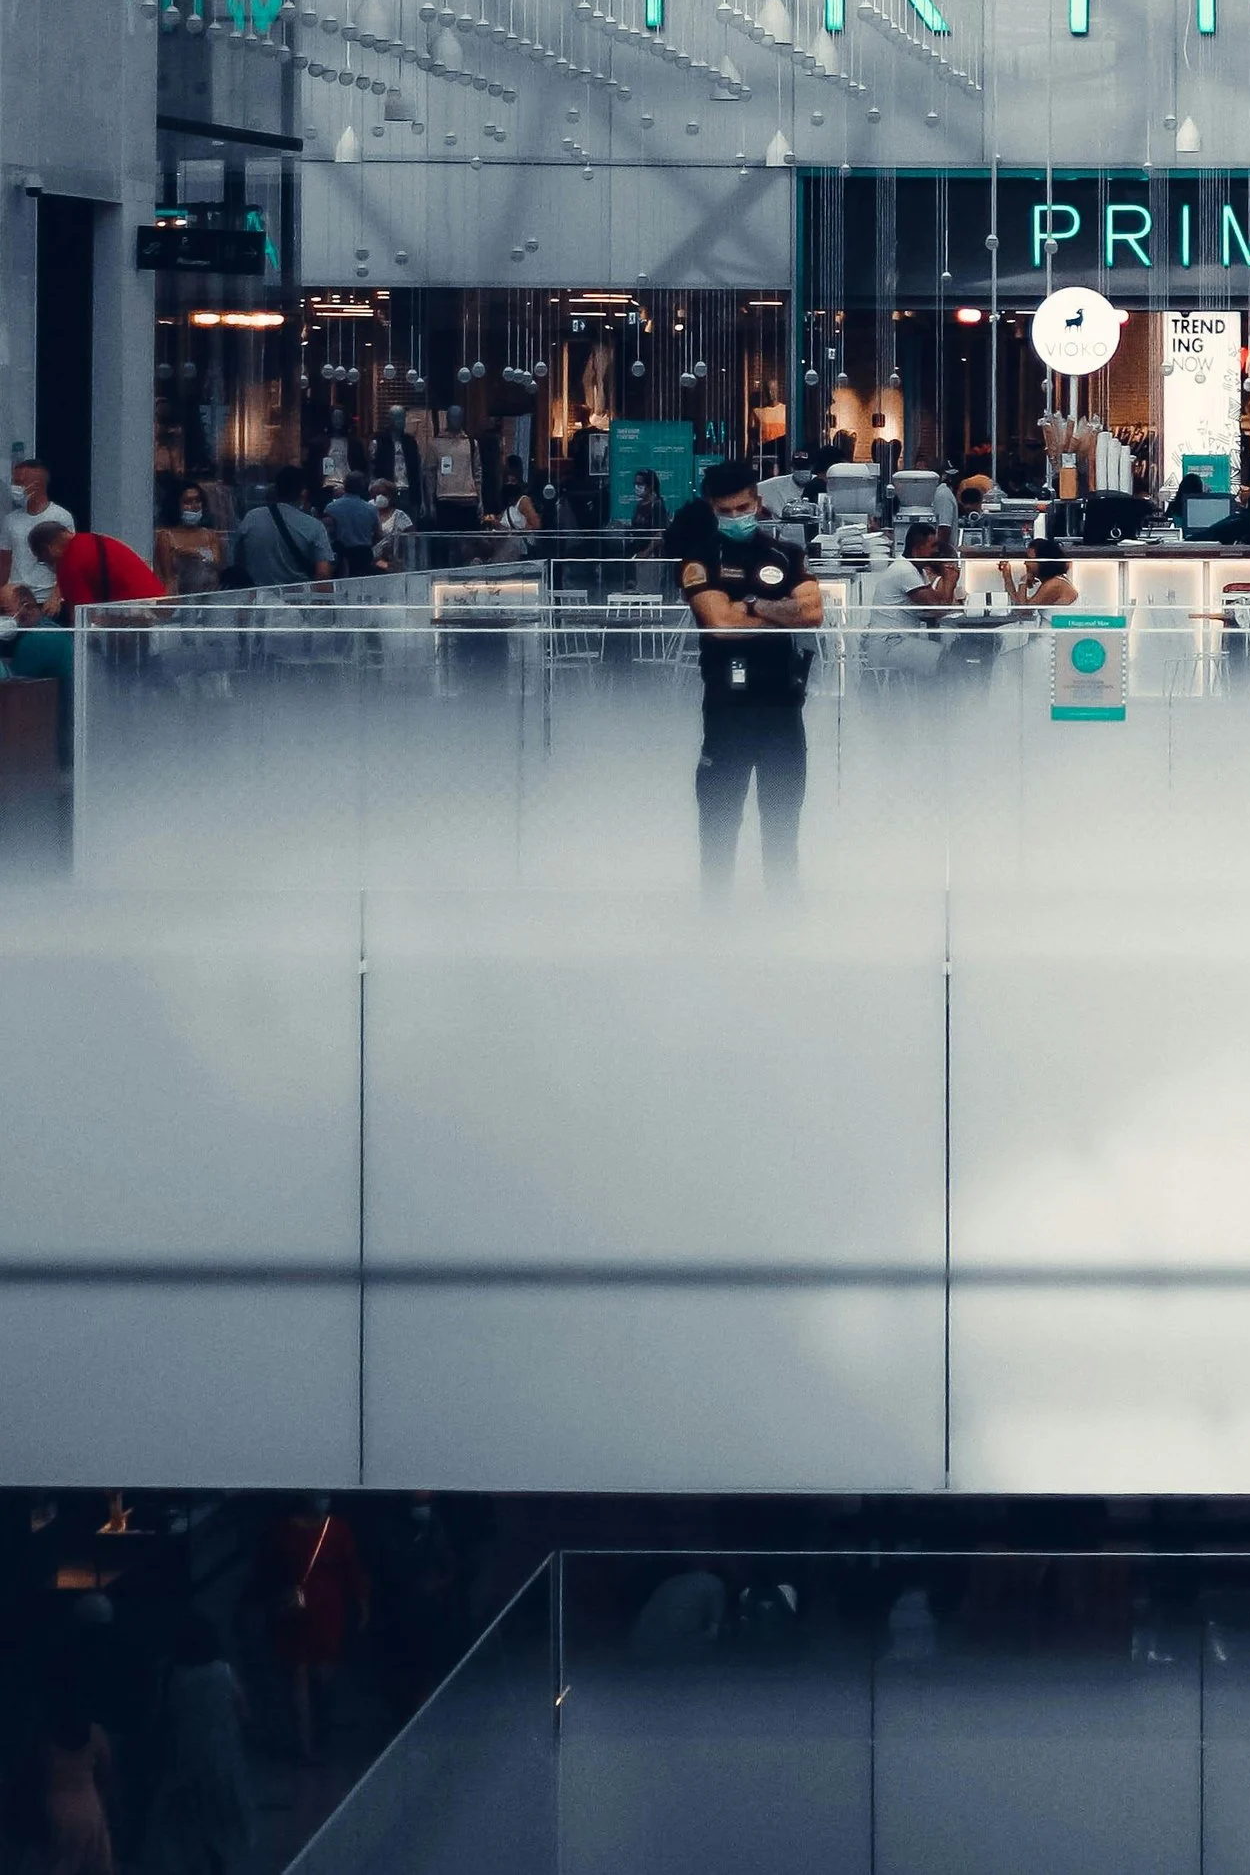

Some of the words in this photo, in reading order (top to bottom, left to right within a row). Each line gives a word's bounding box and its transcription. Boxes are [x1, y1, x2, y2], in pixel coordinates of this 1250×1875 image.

[1172, 318, 1226, 334] TREND
[1045, 341, 1108, 357] VIOKO
[1172, 338, 1204, 353] ING
[1172, 356, 1214, 373] NOW
